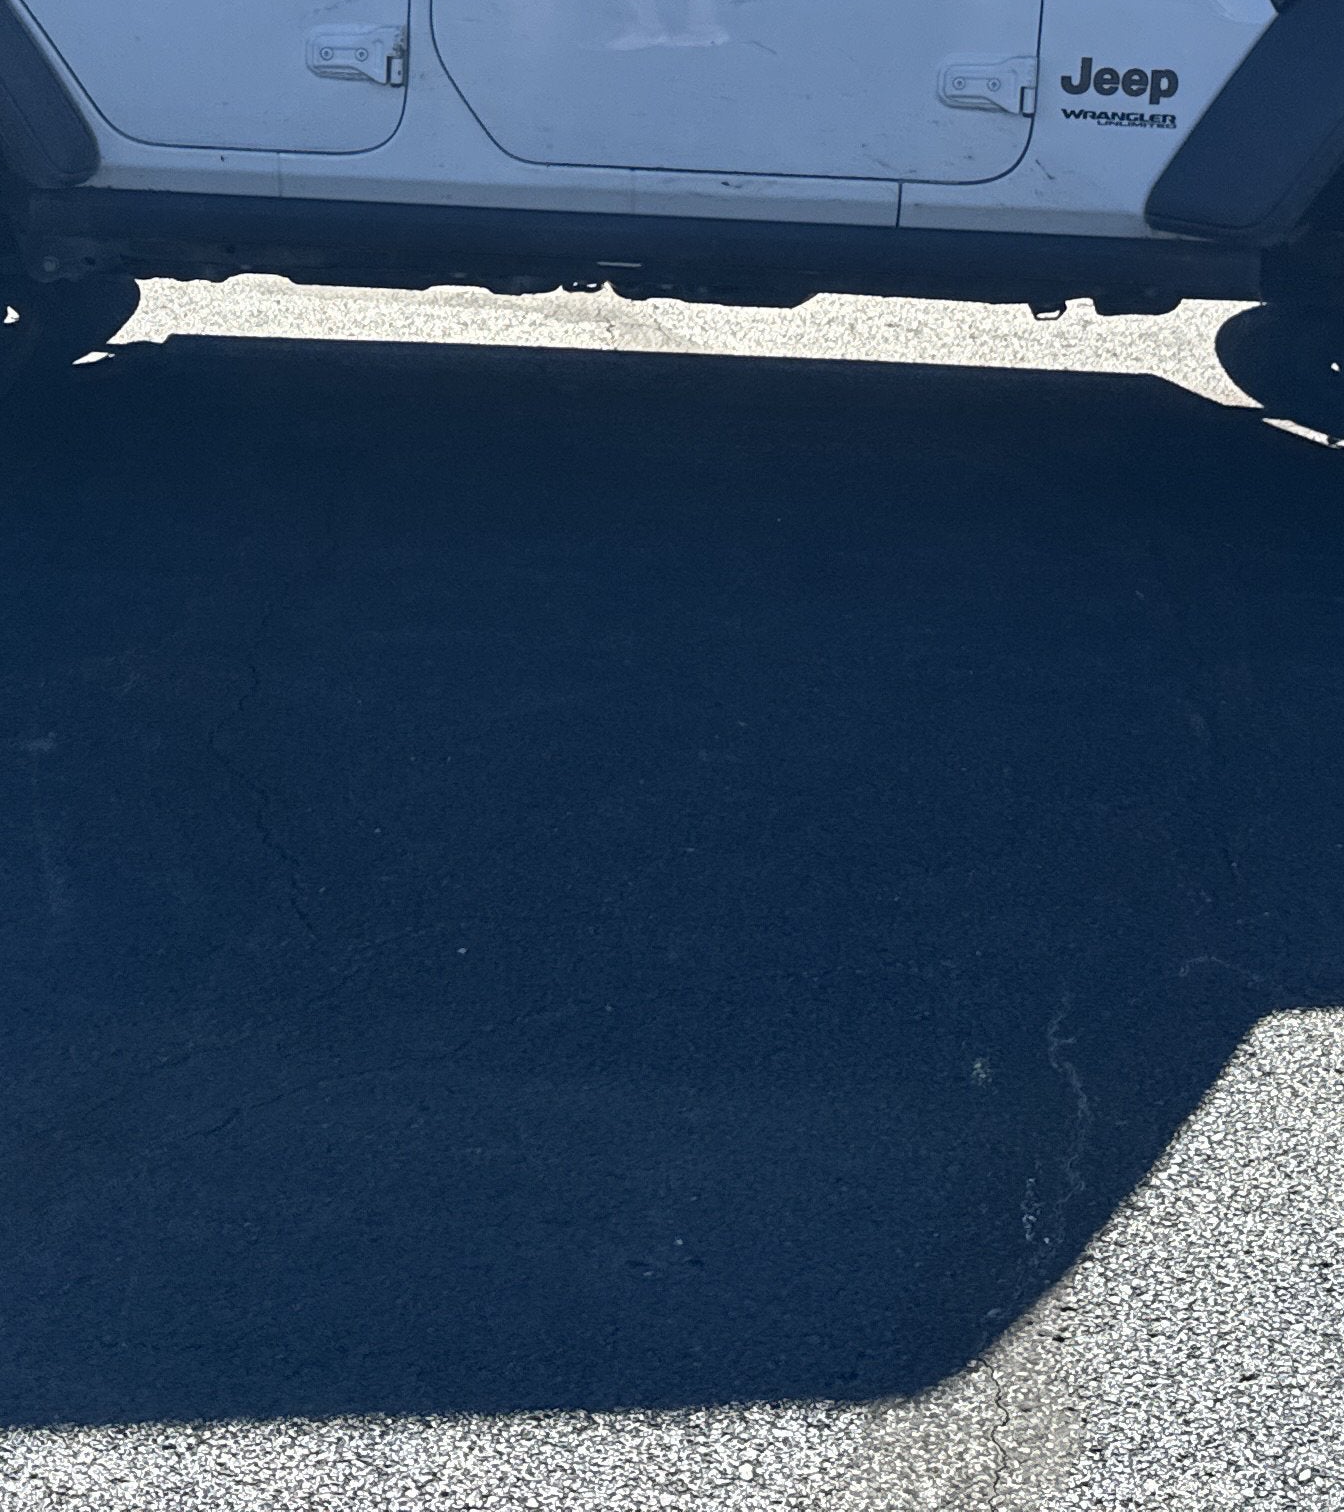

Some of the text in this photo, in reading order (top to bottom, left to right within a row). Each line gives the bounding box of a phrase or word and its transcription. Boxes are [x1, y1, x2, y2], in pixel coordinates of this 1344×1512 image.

[1061, 57, 1179, 105] Jeep
[1061, 108, 1177, 124] WRANGLER
[1097, 120, 1177, 129] UNLIMITED
